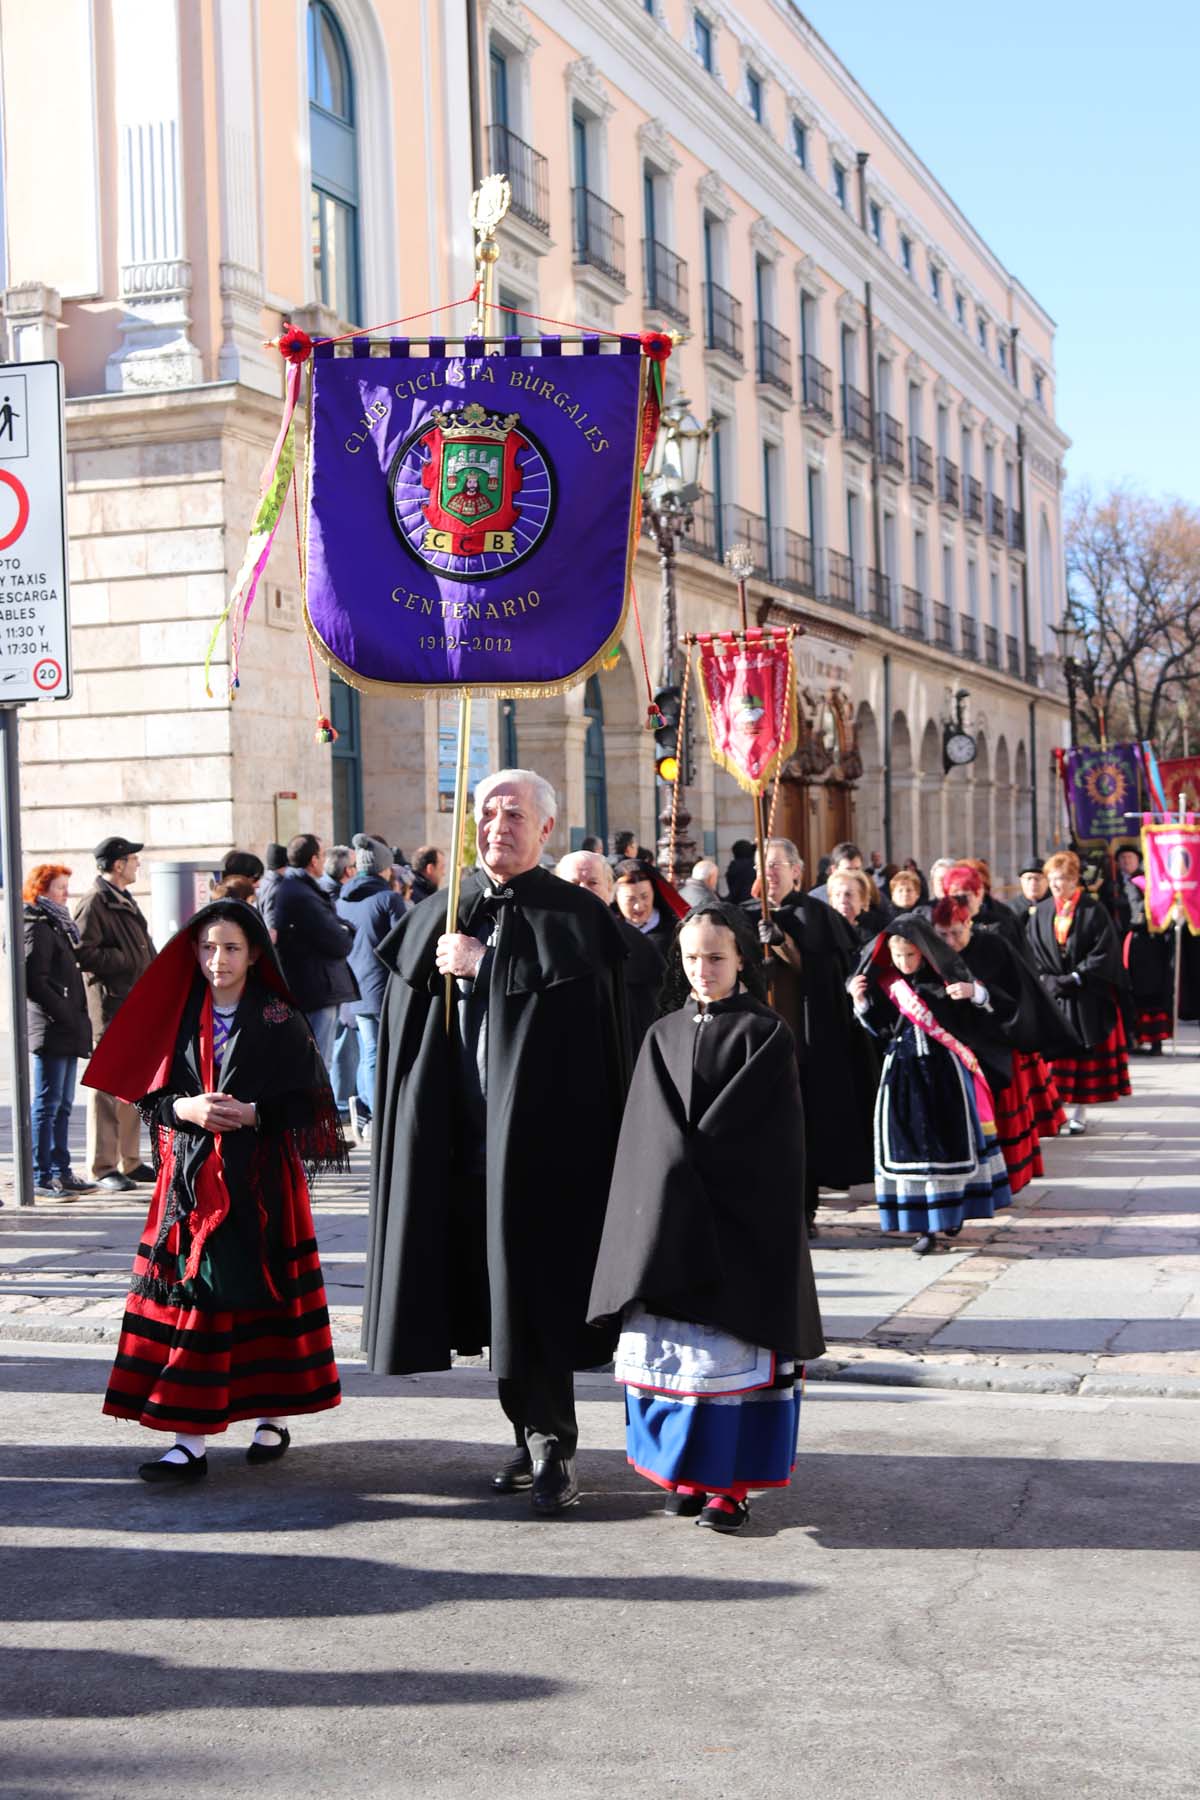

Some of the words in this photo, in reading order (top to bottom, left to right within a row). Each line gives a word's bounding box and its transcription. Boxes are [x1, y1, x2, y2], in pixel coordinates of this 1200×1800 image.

[344, 399, 388, 454] CLUB
[395, 364, 496, 399] CICLISTA
[509, 370, 609, 454] BURGALES
[11, 573, 47, 586] TAXIS
[391, 586, 541, 619] CENTENARIO
[6, 626, 34, 638] 11:30
[38, 625, 45, 637] Y
[7, 642, 37, 655] 17:30
[40, 641, 52, 653] H.
[418, 636, 512, 652] 1912-2012
[39, 668, 56, 680] 20
